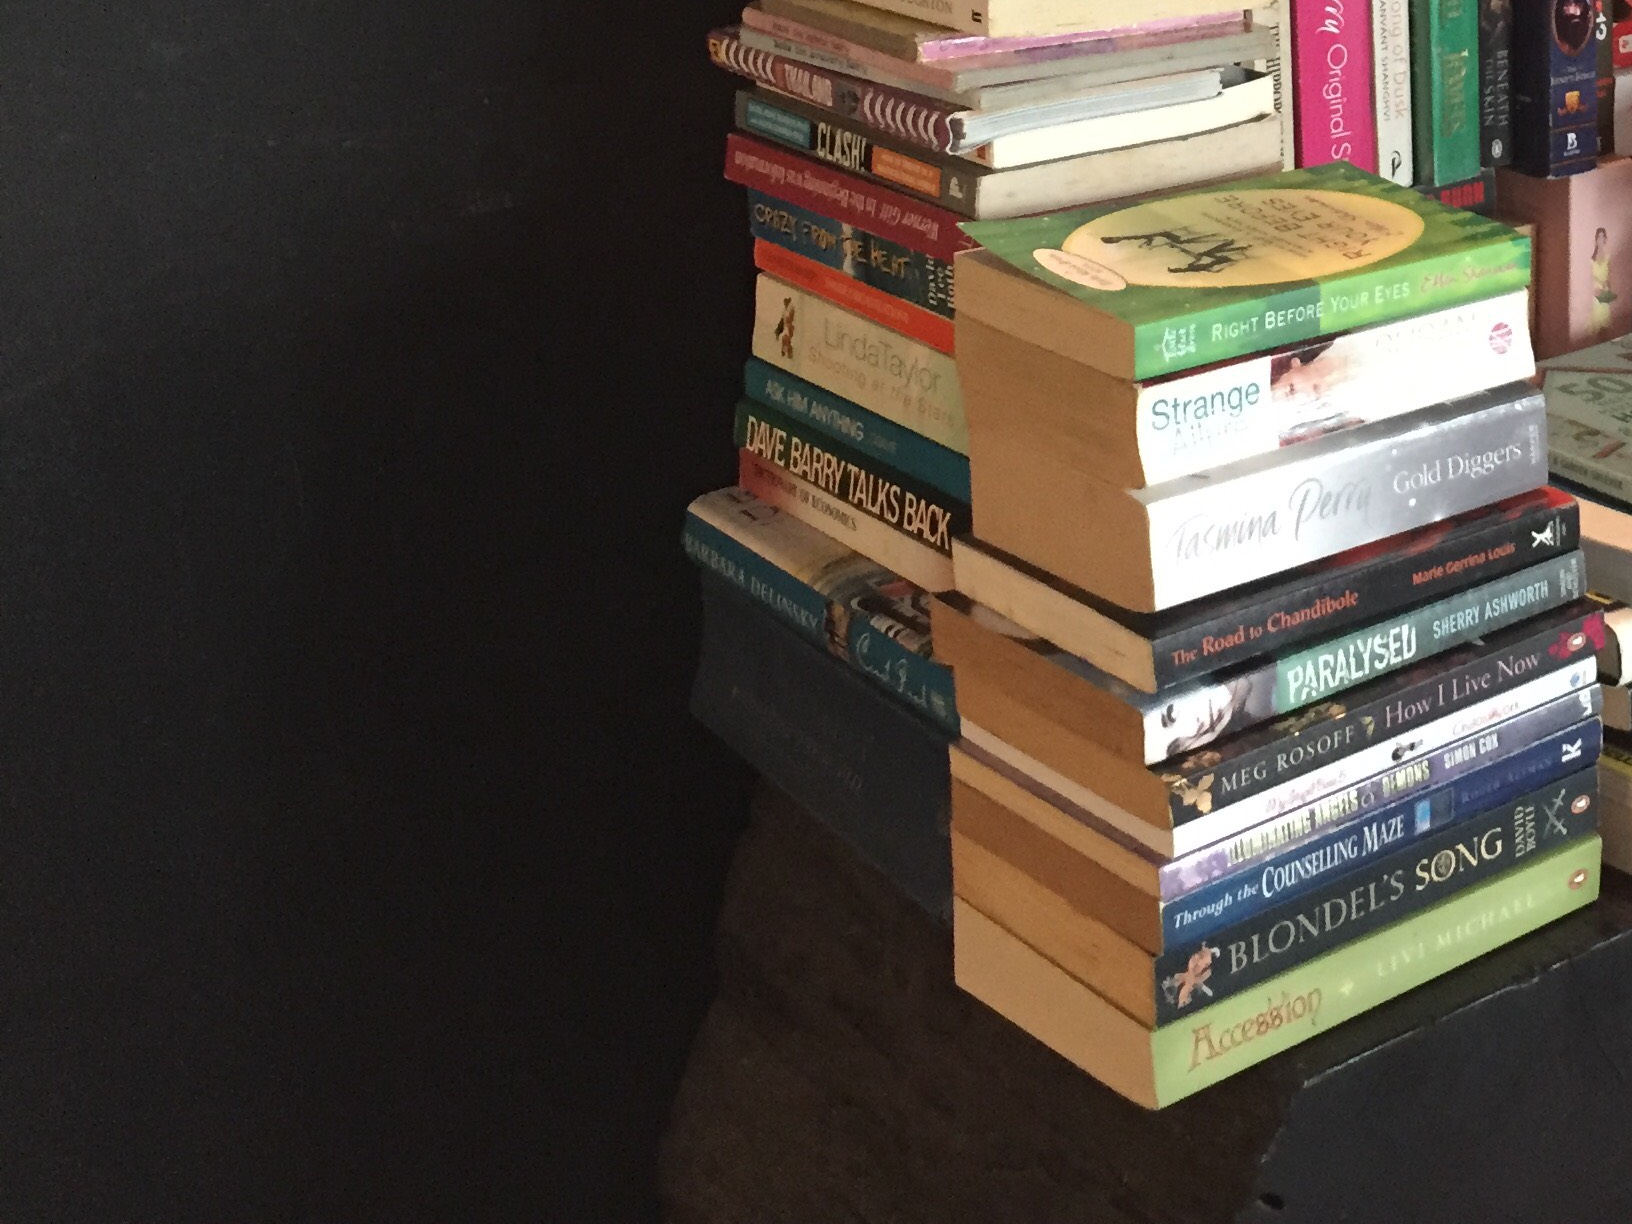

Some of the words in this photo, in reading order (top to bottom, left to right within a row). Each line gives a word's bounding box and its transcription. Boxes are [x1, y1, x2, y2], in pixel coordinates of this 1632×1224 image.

[1322, 43, 1352, 140] Original
[1393, 43, 1406, 65] of
[1393, 69, 1408, 120] Dusk
[1496, 49, 1509, 127] BENEATH
[815, 121, 868, 173] CLASH!
[1210, 314, 1259, 343] RIGHT
[1264, 298, 1326, 331] BEFORE
[1329, 290, 1370, 320] YOUR
[1373, 281, 1412, 305] EYES
[1151, 381, 1261, 432] Strange
[745, 414, 788, 467] DAVE
[789, 436, 846, 494] BARRY
[846, 462, 901, 524] TALKS
[902, 491, 952, 550] BACK
[1169, 505, 1282, 562] Tasmina
[1288, 476, 1373, 542] Perry
[1393, 463, 1442, 496] Gold
[1446, 440, 1523, 480] Diggers
[1171, 647, 1198, 669] The
[1202, 625, 1246, 654] Road
[1249, 623, 1264, 642] to
[1266, 588, 1360, 636] Chandibole
[1412, 564, 1444, 586] Marie
[1286, 622, 1418, 705] PARALYSED
[1432, 605, 1480, 640] SHERRY
[1483, 579, 1550, 619] ASHWORTH
[1219, 760, 1269, 798] MEG
[1276, 727, 1357, 774] ROSOFF
[1384, 701, 1433, 731] How
[1437, 684, 1447, 707] I
[1450, 669, 1492, 697] Live
[1497, 652, 1542, 681] Now
[1311, 789, 1360, 832] ANGELS
[1382, 761, 1432, 799] DEMONS
[1443, 743, 1477, 771] SIMON
[1477, 733, 1500, 759] COX
[1513, 806, 1526, 858] DAVID
[1173, 894, 1235, 931] Through
[1237, 880, 1261, 904] the
[1261, 833, 1360, 900] COUNSELLING
[1362, 816, 1406, 856] MAZE
[1226, 868, 1405, 976] BLONDEL'S
[1412, 825, 1504, 894] SONG
[1187, 986, 1324, 1074] Accession
[1375, 943, 1427, 978] LIVI
[1434, 892, 1538, 953] MICHAEL
